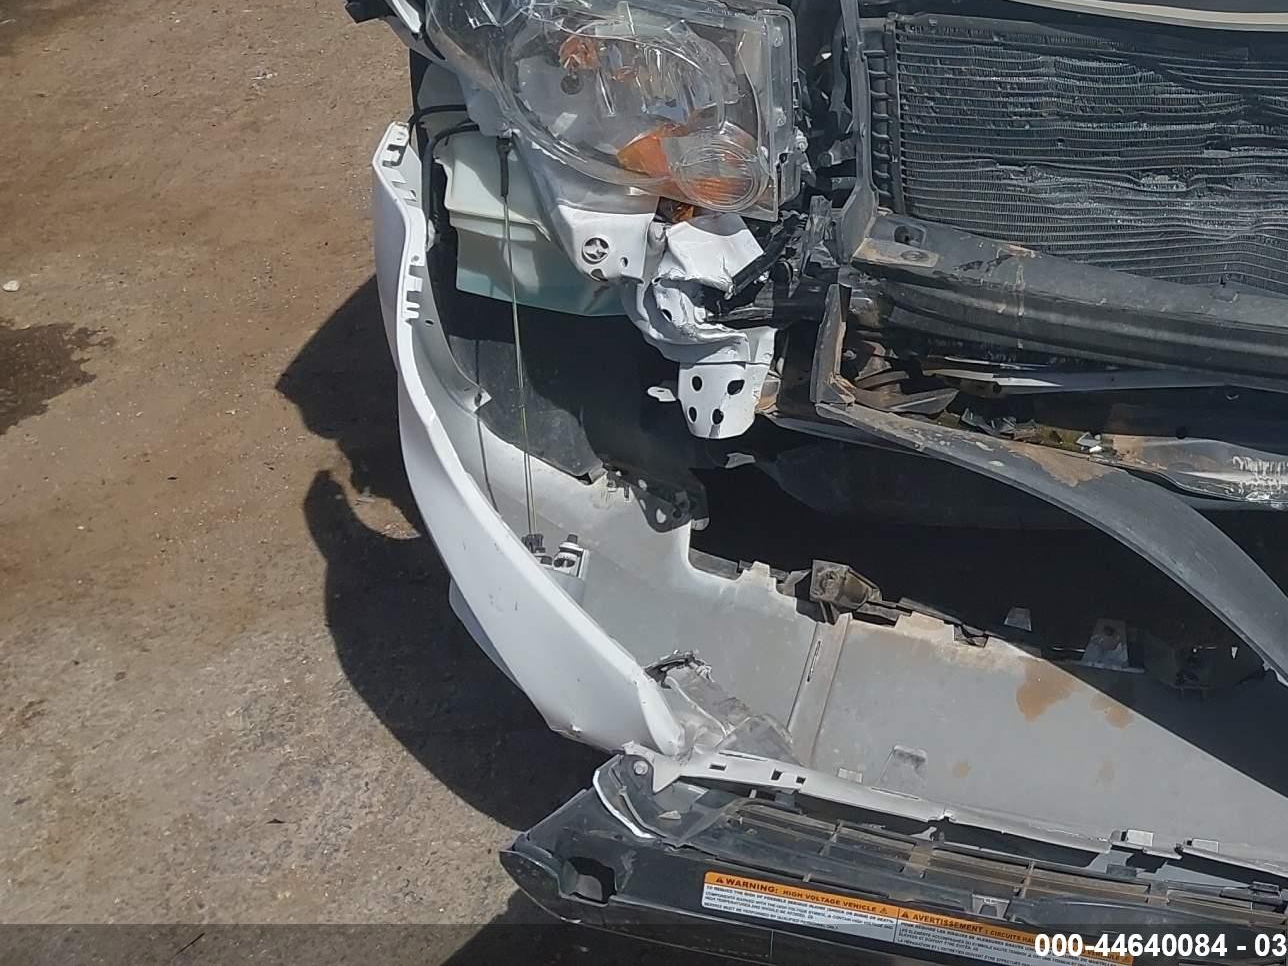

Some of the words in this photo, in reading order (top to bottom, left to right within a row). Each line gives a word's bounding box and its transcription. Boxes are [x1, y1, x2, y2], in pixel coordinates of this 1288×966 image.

[725, 878, 778, 894] WARNING:
[783, 889, 803, 899] HIGH
[805, 894, 841, 906] VOLTAGE
[843, 901, 877, 912] VEHICLE
[912, 914, 983, 933] AVERTISSEMENT
[990, 929, 1021, 941] CIRCUITS
